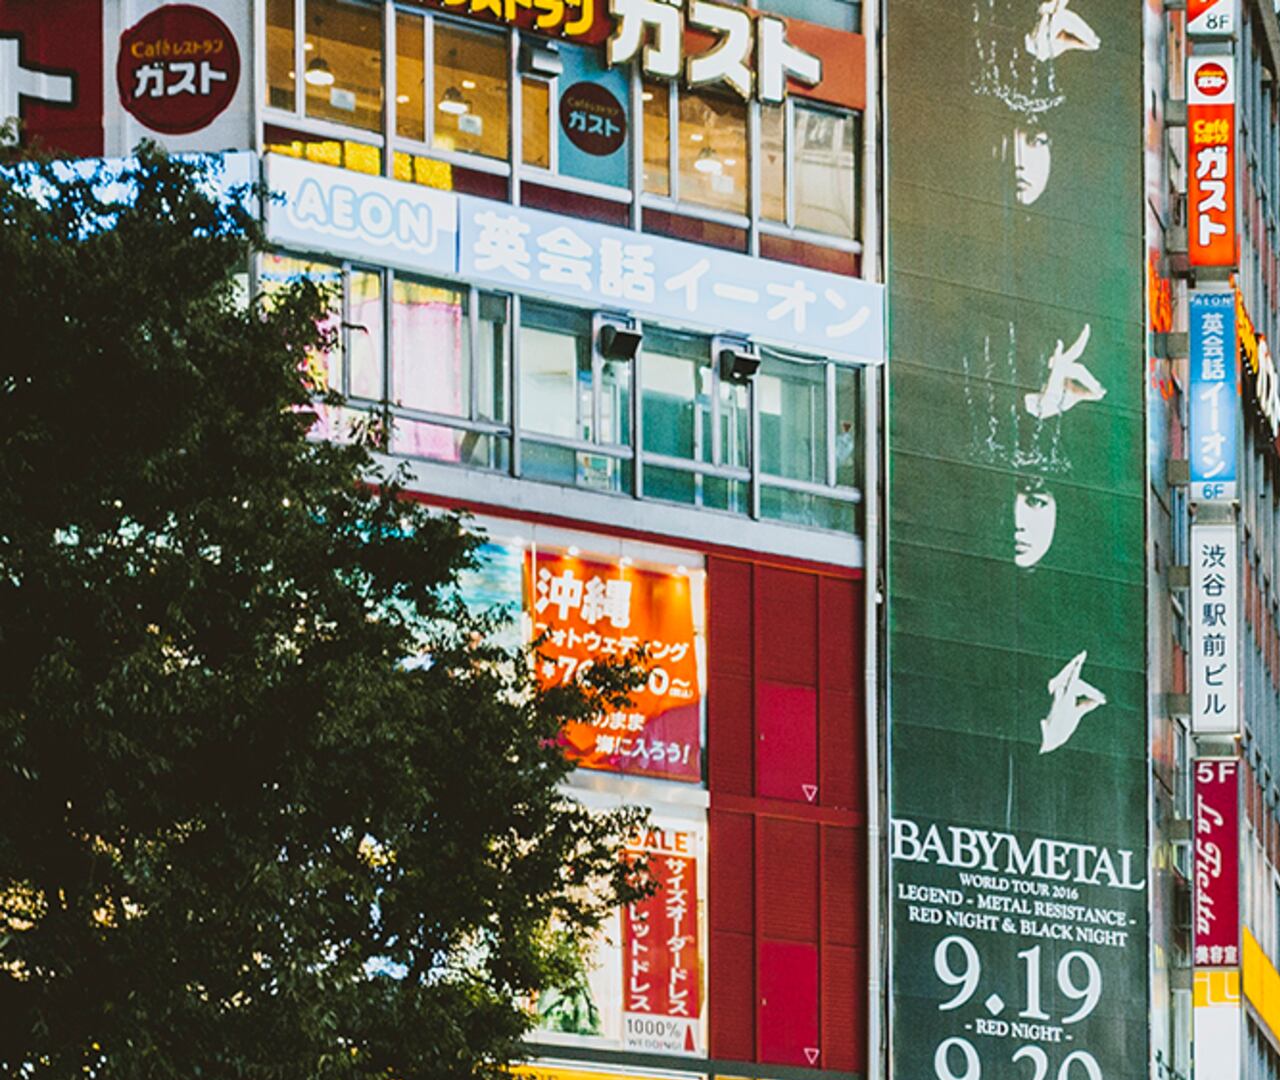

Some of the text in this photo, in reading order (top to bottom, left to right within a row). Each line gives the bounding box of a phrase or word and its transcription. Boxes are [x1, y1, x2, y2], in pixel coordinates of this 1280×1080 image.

[1206, 14, 1230, 30] 8F
[608, 0, 823, 104] ガスト
[134, 61, 228, 98] ガスト
[567, 110, 621, 138] ガスト
[296, 180, 435, 249] AEON
[1197, 146, 1228, 248] ガスト
[1202, 483, 1225, 499] 6F
[536, 567, 632, 630] 沖縄
[1201, 543, 1228, 717] 渋谷駅前ビル
[1197, 763, 1237, 784] 5F
[627, 829, 689, 854] SALE
[891, 819, 1146, 890] BABYMETAL
[898, 883, 1127, 927] LEGEND METAL RESISTANCE
[959, 872, 1079, 901] WORLD TOUR 2016
[626, 853, 651, 1012] アレットドレス
[664, 857, 690, 1017] サイズオーダードレス
[908, 904, 1129, 947] RED NIGHT & BLACK NIGHT
[934, 935, 1102, 1024] 9.19
[627, 1018, 682, 1039] 1000%
[976, 1018, 1064, 1042] RED NIGHT
